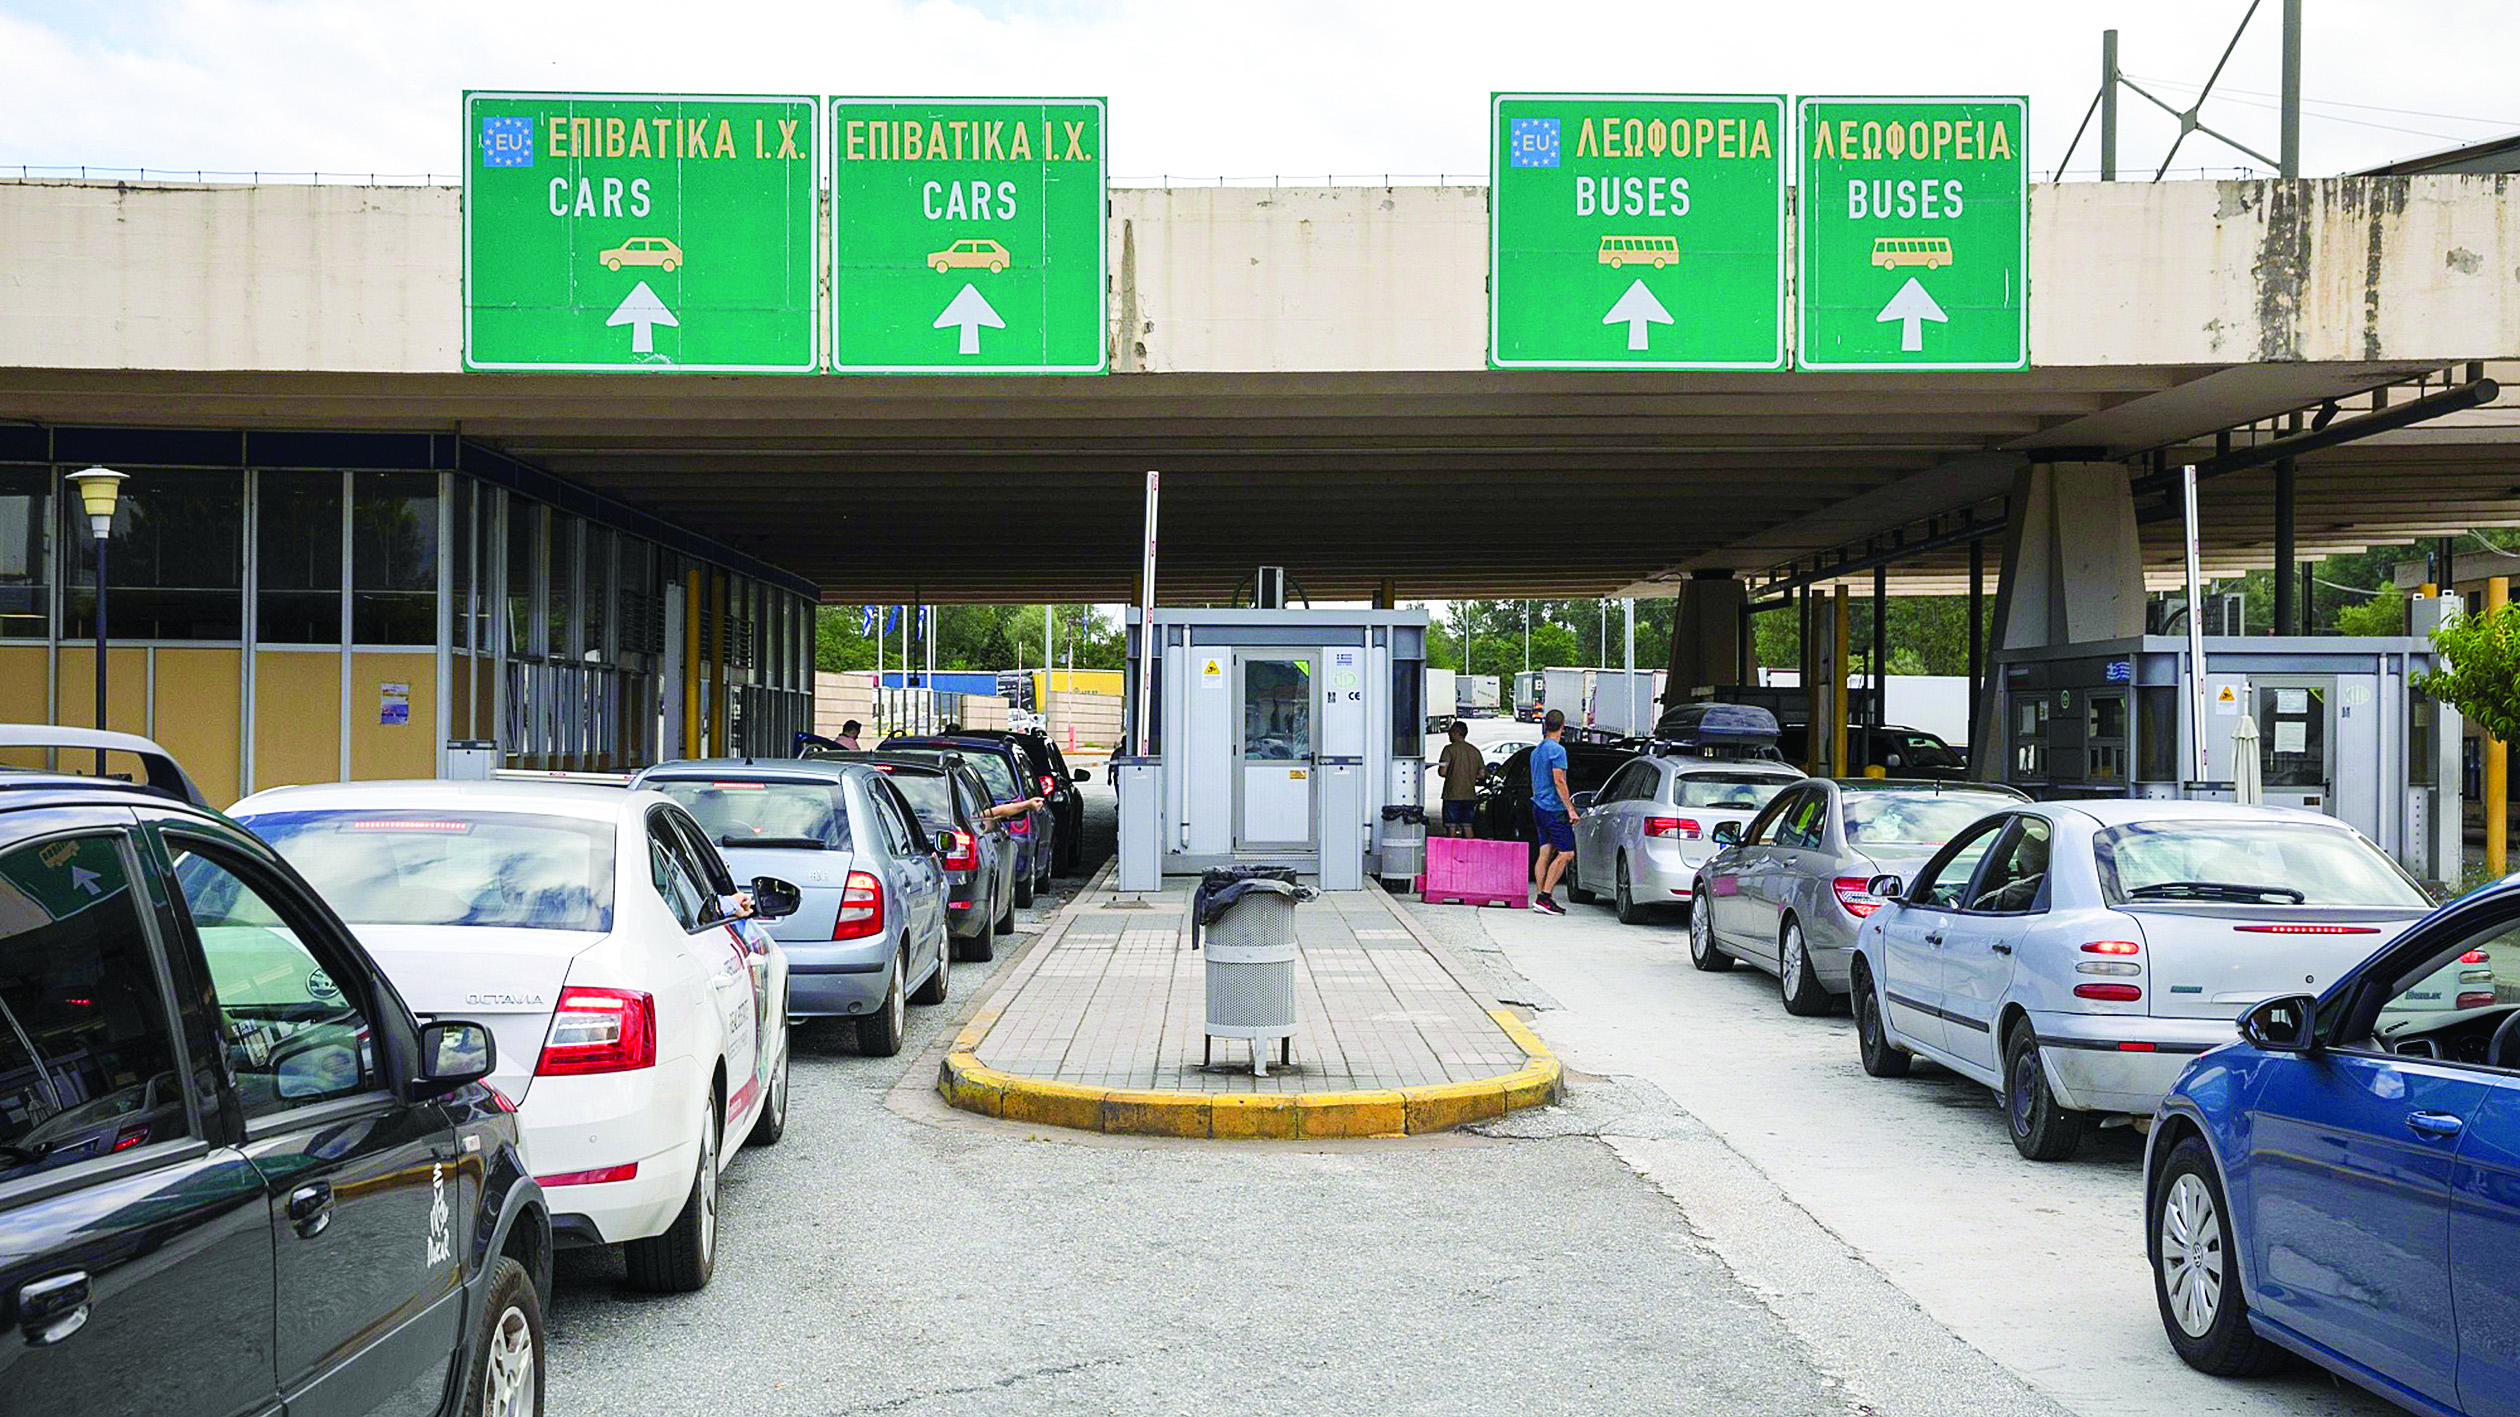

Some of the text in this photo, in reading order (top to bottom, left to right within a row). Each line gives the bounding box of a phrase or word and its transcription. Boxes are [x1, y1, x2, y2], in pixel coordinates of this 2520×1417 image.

[495, 133, 523, 151] EU
[549, 117, 736, 159] ΕΠΙΒΑΤΙΚΑ
[846, 119, 1032, 161] ΕΠΙΒΑΤΙΚΑ
[1522, 134, 1550, 152] EU
[1576, 117, 1772, 159] ΛΕΩΦΟΡΕΙΑ
[1813, 118, 2011, 160] ΛΕΩΦΟΡΕΙΑ
[549, 177, 650, 218] CARS
[923, 180, 1017, 221] CARS
[1576, 176, 1690, 217] BUSES
[1848, 179, 1963, 219] BUSES
[1348, 691, 1361, 701] CE
[465, 992, 544, 1005] OCTAVIA
